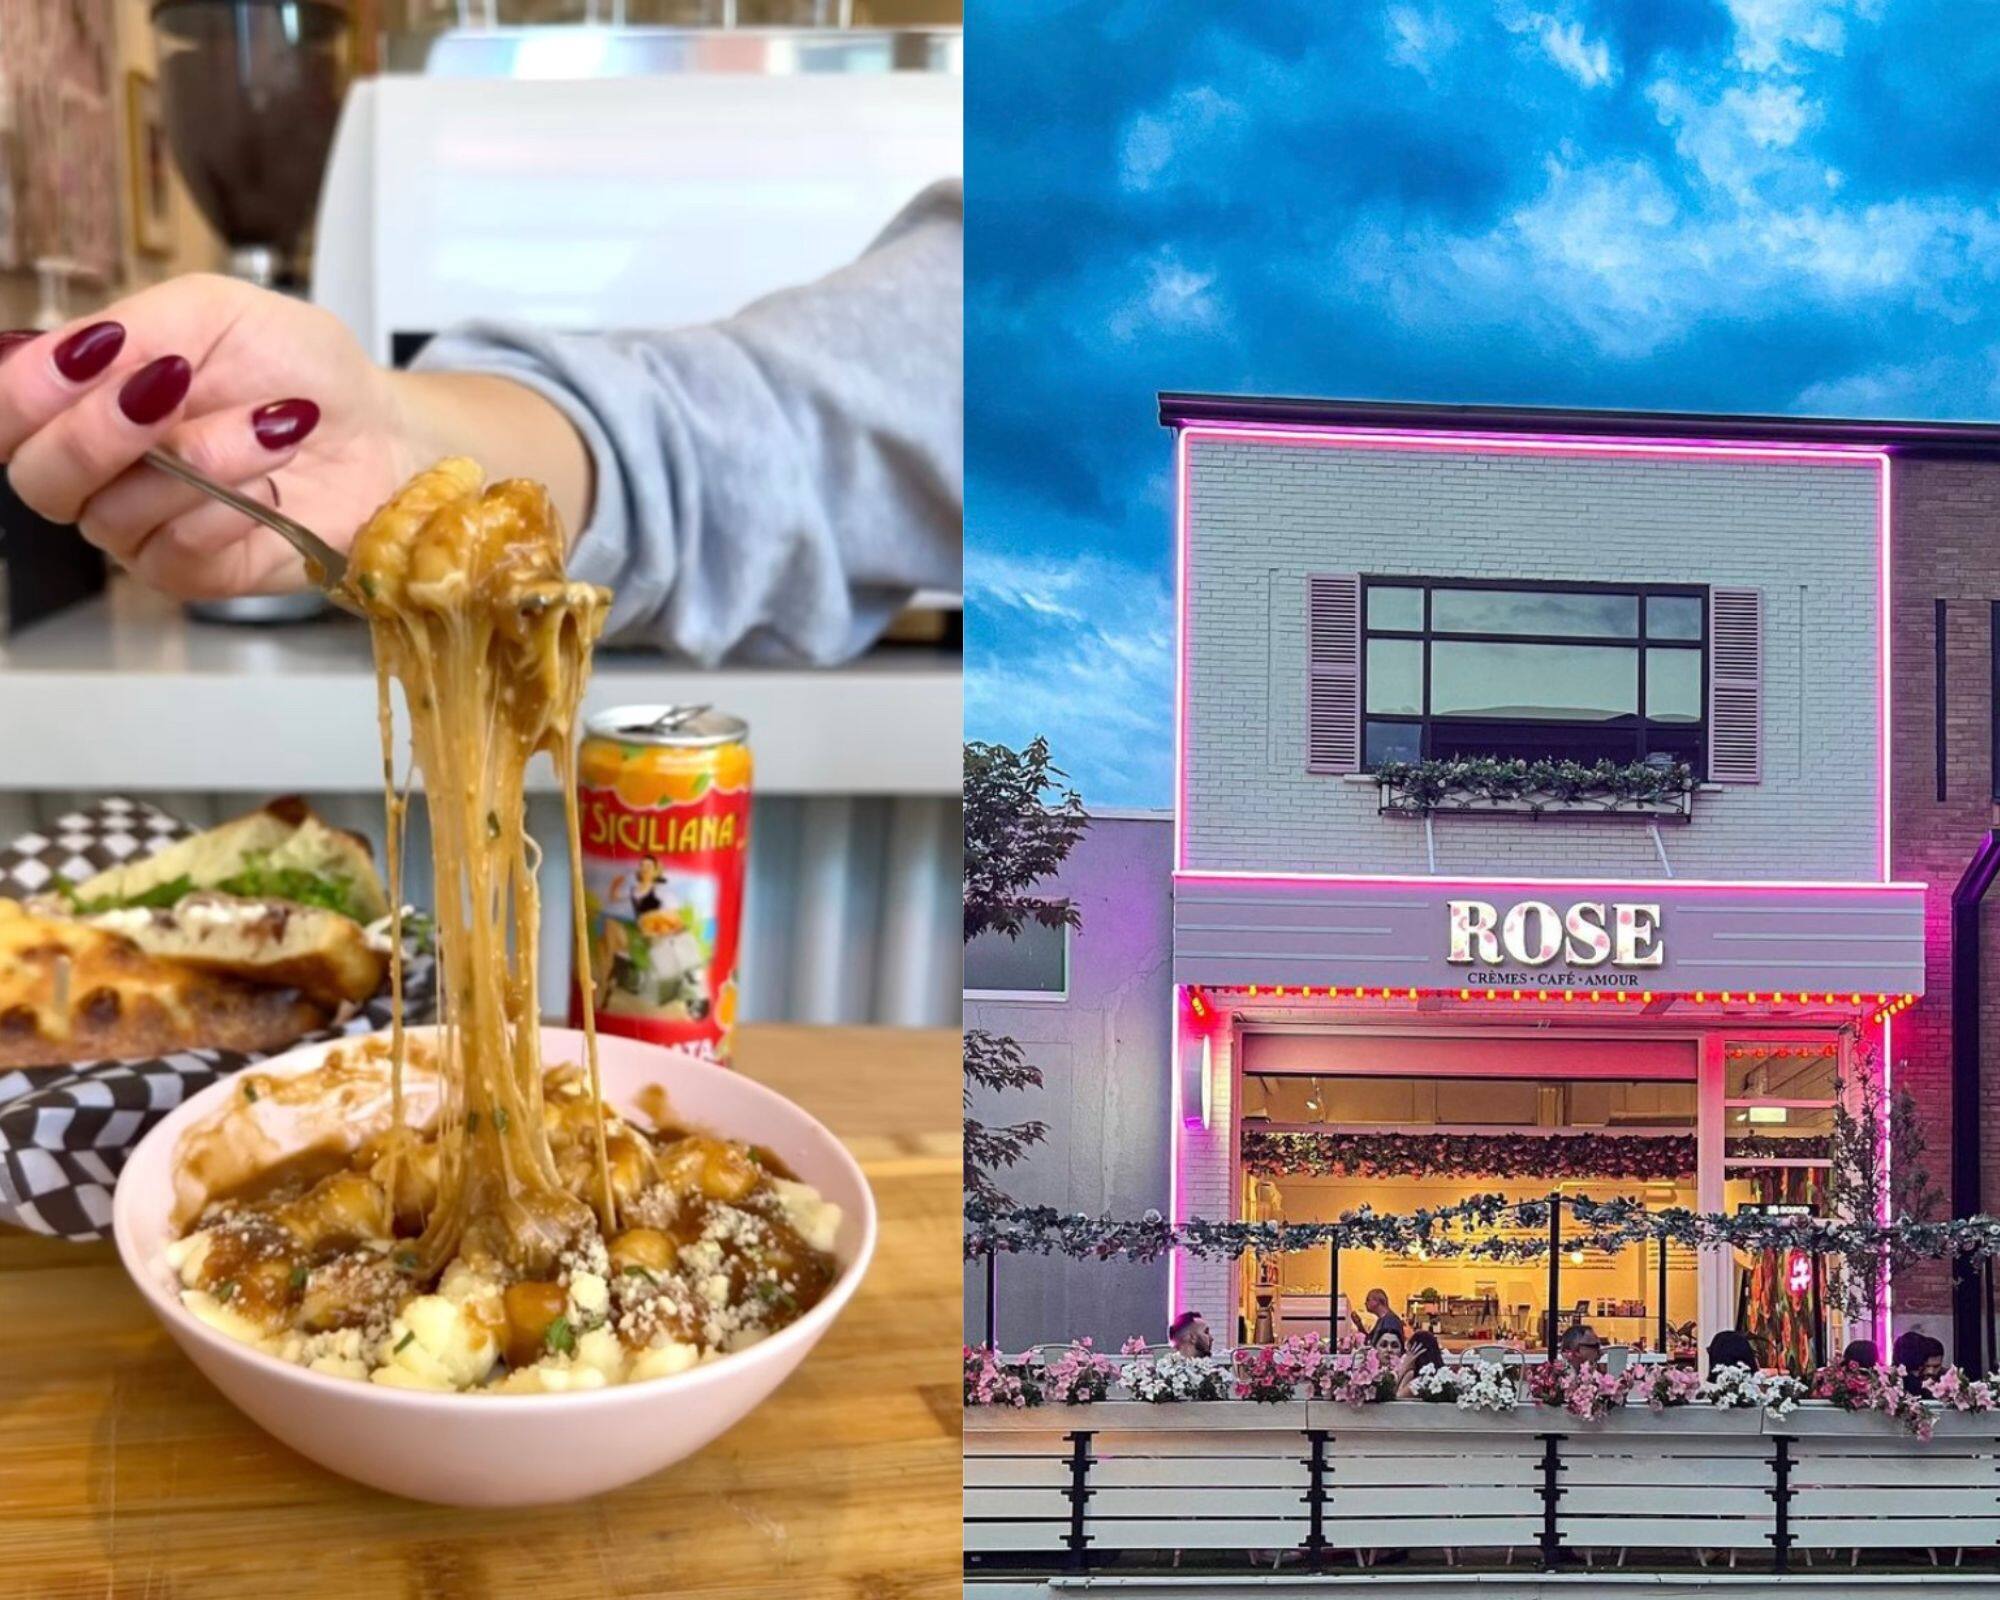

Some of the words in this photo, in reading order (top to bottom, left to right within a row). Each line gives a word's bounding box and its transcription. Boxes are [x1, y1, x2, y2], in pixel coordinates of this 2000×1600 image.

[589, 803, 736, 852] SICILIANA
[1447, 900, 1664, 966] ROSE
[1467, 969, 1528, 986] CRÈMES
[1537, 971, 1576, 987] CAFÉ
[1584, 973, 1639, 987] AMOUR
